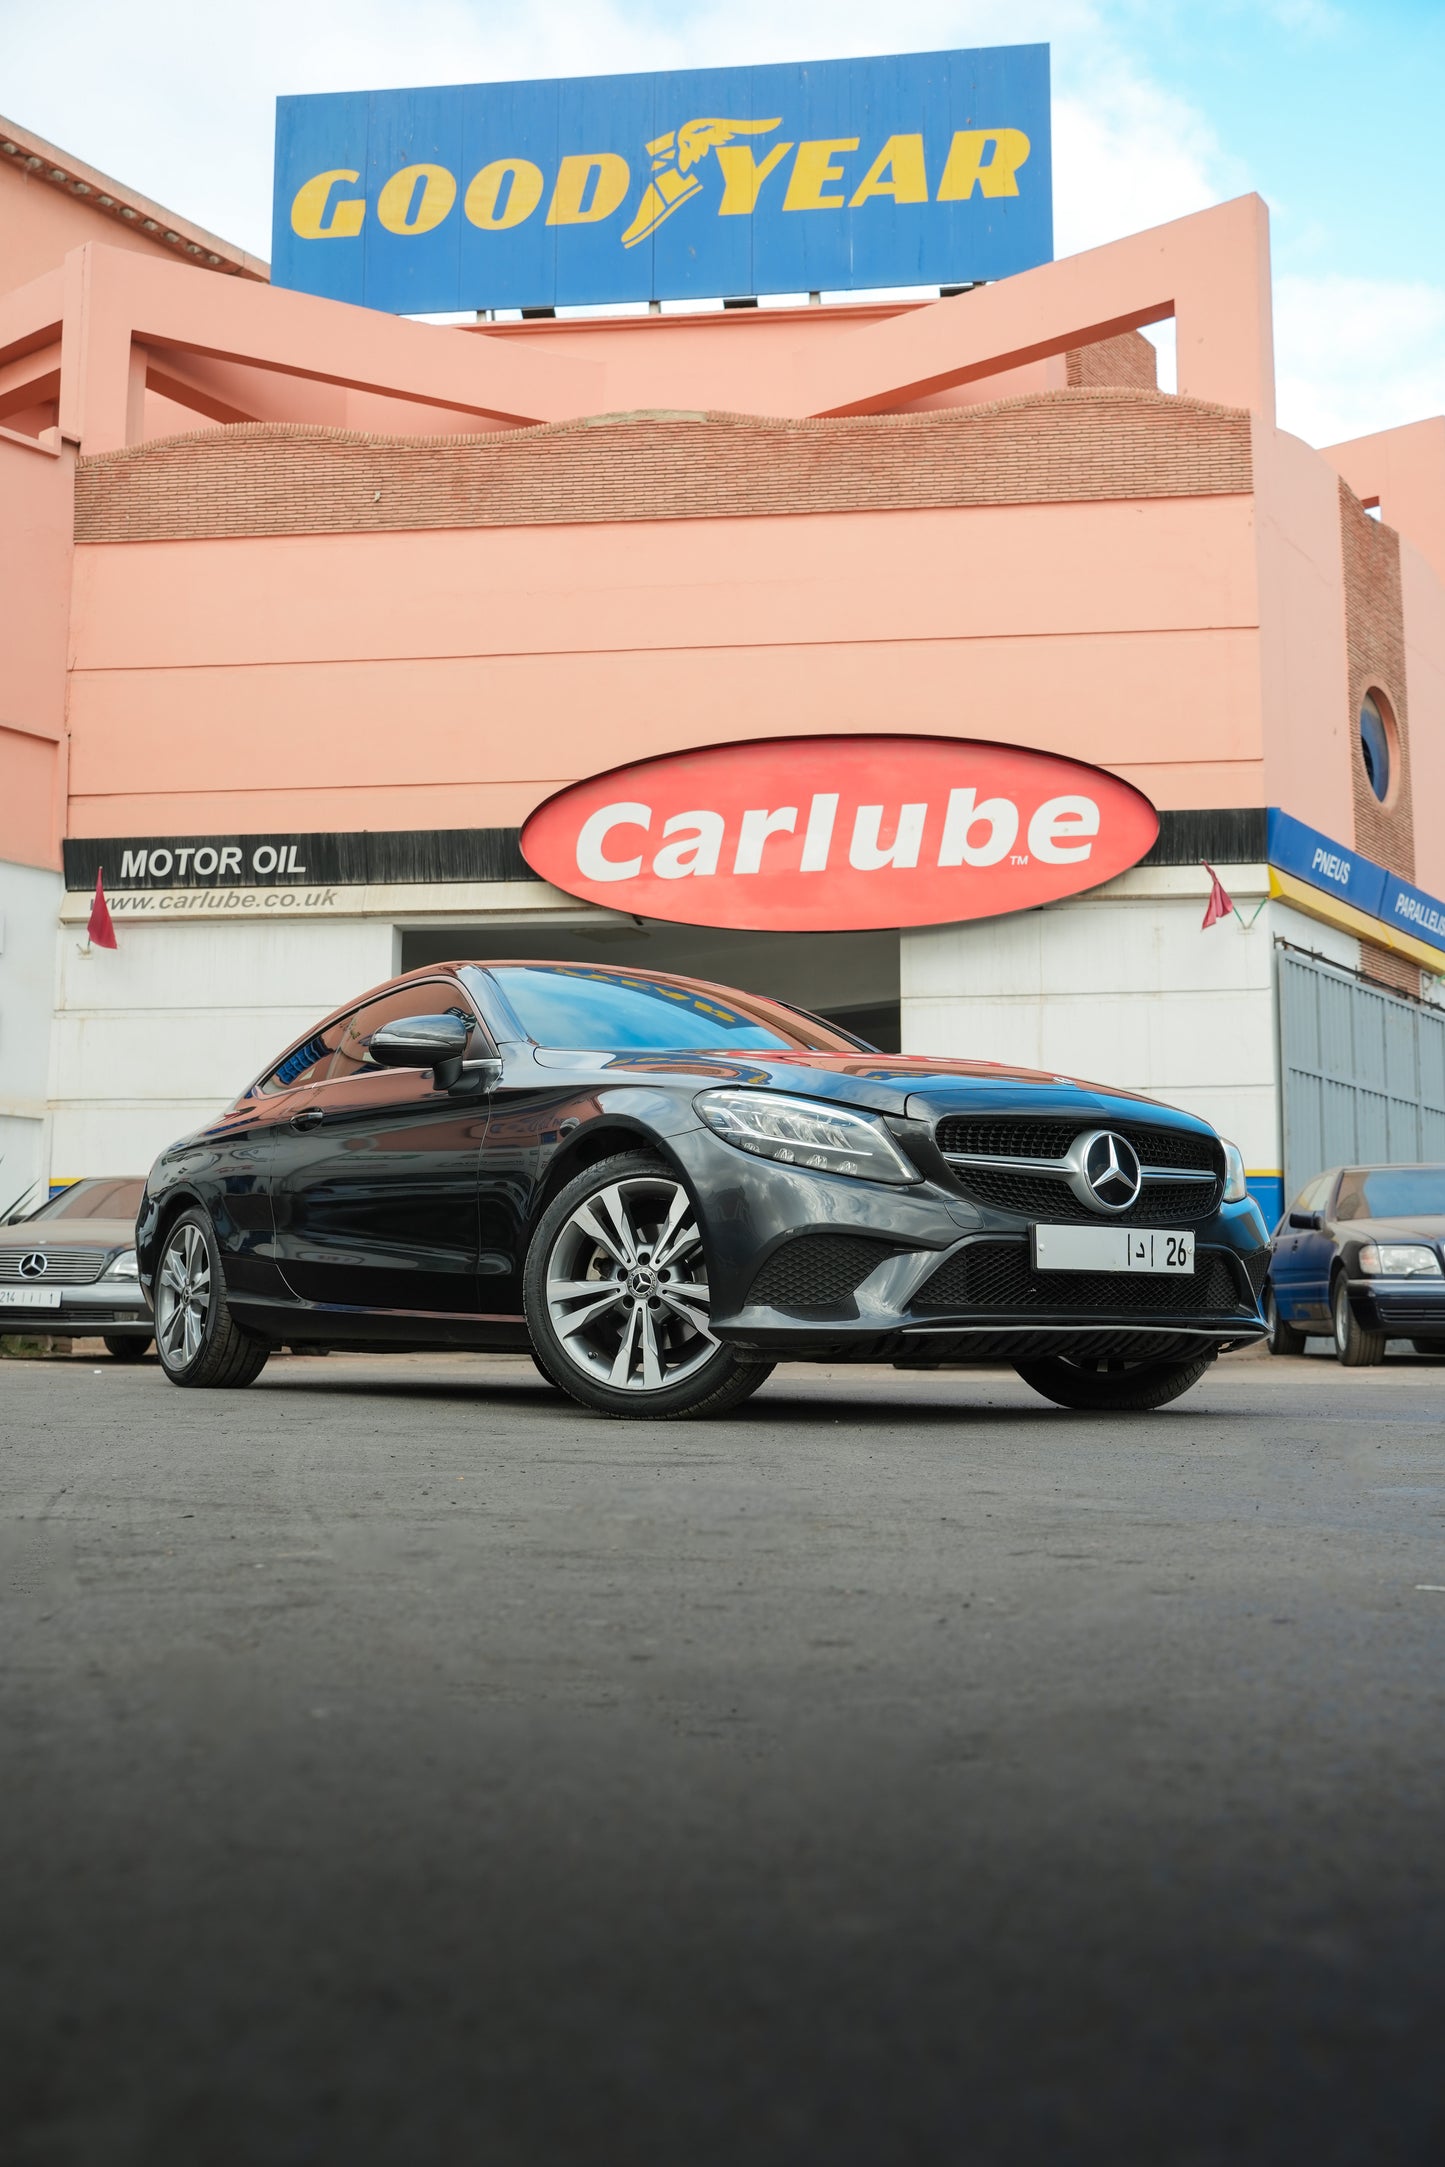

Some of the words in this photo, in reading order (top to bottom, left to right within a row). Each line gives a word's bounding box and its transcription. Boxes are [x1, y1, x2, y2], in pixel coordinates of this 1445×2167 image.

[575, 787, 1101, 882] Carlube
[120, 847, 243, 878] MOTOR
[252, 845, 307, 874] OIL
[1311, 848, 1350, 885] PNEUS
[1166, 1237, 1187, 1267] 26
